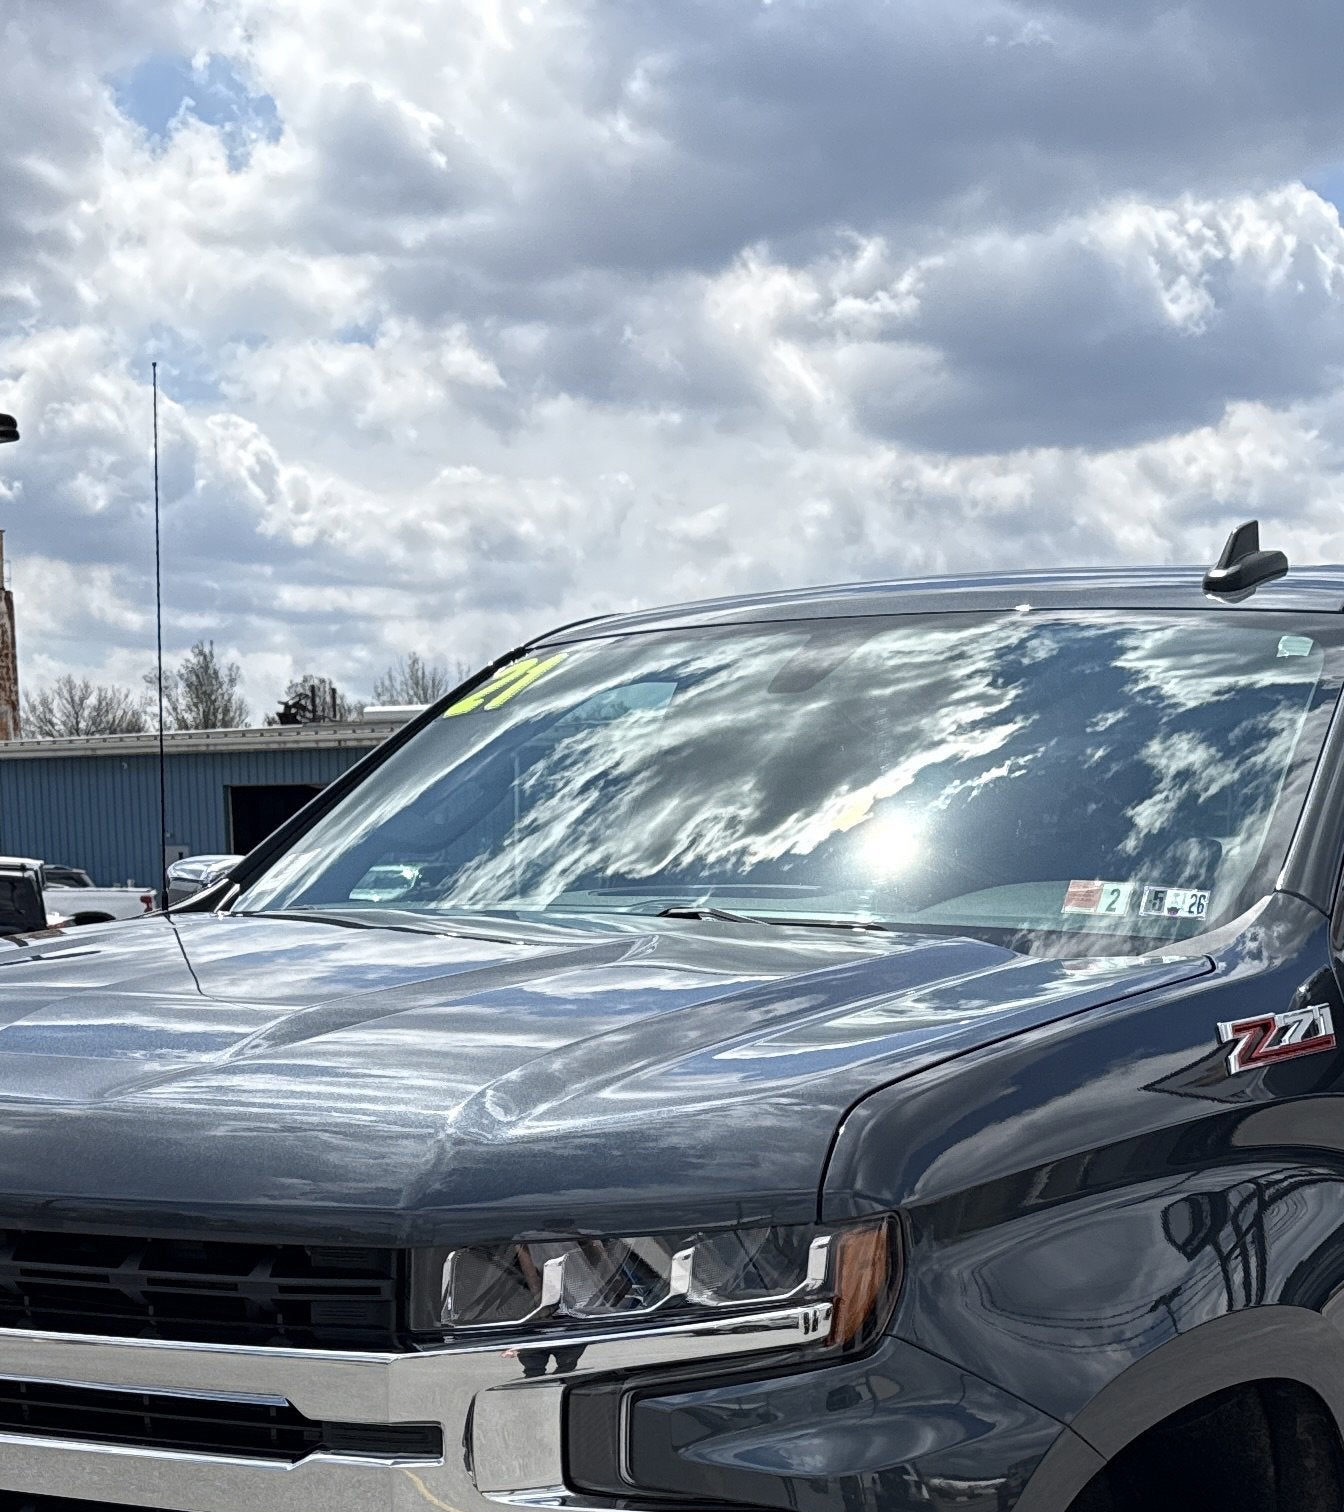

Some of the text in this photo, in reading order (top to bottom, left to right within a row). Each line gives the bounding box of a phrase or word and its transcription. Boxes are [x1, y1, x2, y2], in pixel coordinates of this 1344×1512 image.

[442, 652, 570, 718] 21
[1105, 888, 1121, 912] 2
[1187, 893, 1207, 914] 26
[1216, 1002, 1337, 1075] Z71
